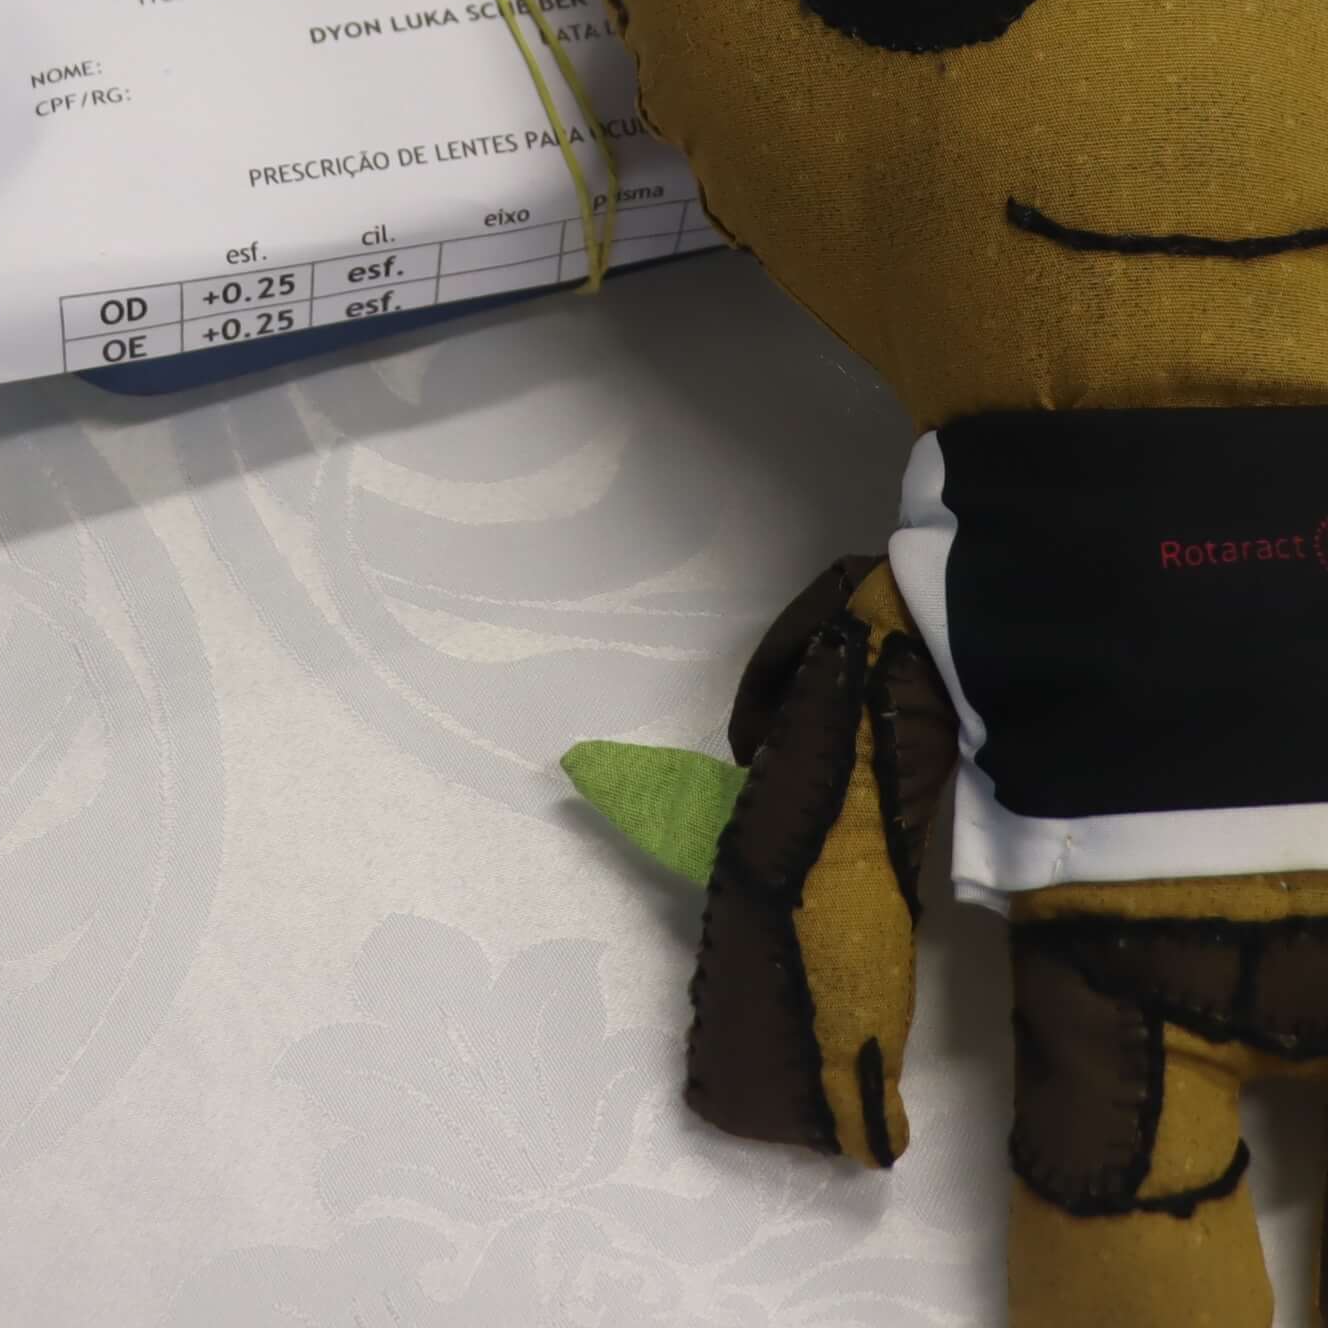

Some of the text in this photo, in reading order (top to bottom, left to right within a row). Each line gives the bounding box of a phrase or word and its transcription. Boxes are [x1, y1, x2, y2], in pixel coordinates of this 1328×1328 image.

[308, 18, 382, 45] DYON
[390, 8, 459, 33] LUKA
[30, 59, 102, 89] NOME:
[35, 87, 133, 118] CPF/RG:
[248, 149, 390, 188] PRESCRIÇÃO
[397, 146, 427, 167] DE
[435, 133, 519, 162] LENTES
[225, 184, 664, 265] esf. cil. eixo pisma
[100, 256, 404, 325] OD +0.25 esf.
[102, 290, 402, 363] OE +0.25 esf.
[1159, 535, 1307, 569] Rotaract
